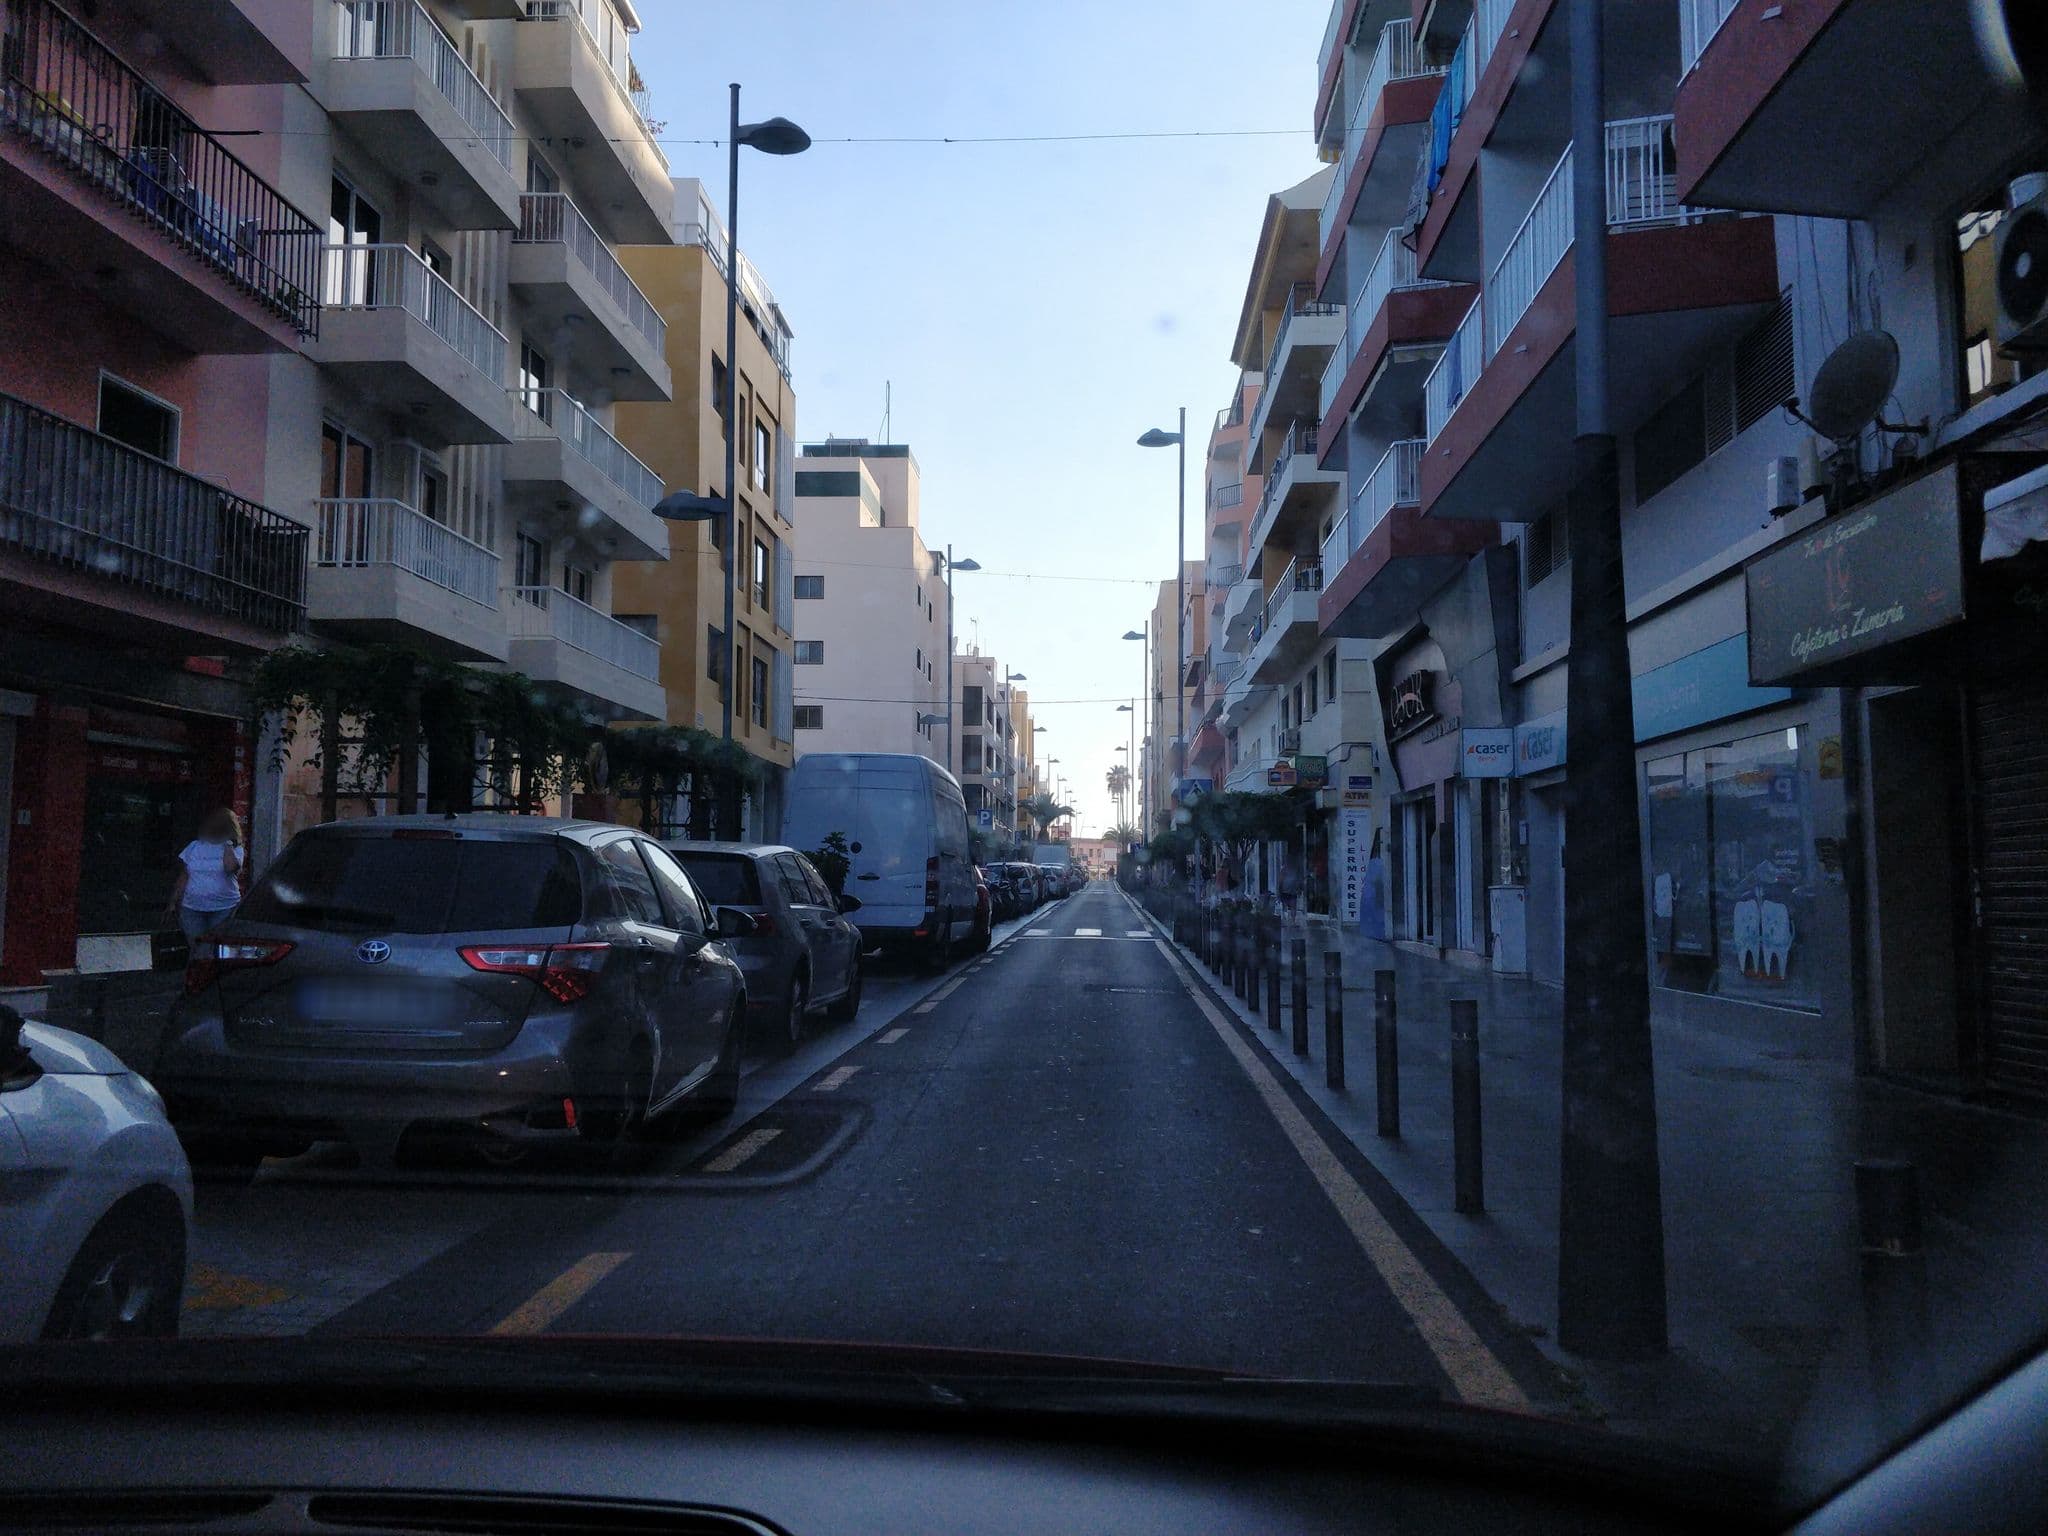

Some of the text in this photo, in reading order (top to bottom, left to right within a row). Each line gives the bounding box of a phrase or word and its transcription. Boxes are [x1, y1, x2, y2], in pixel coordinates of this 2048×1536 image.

[1475, 744, 1509, 754] caser
[1345, 792, 1369, 800] ATM
[980, 811, 990, 826] P
[1347, 820, 1357, 918] SUPERMARKET
